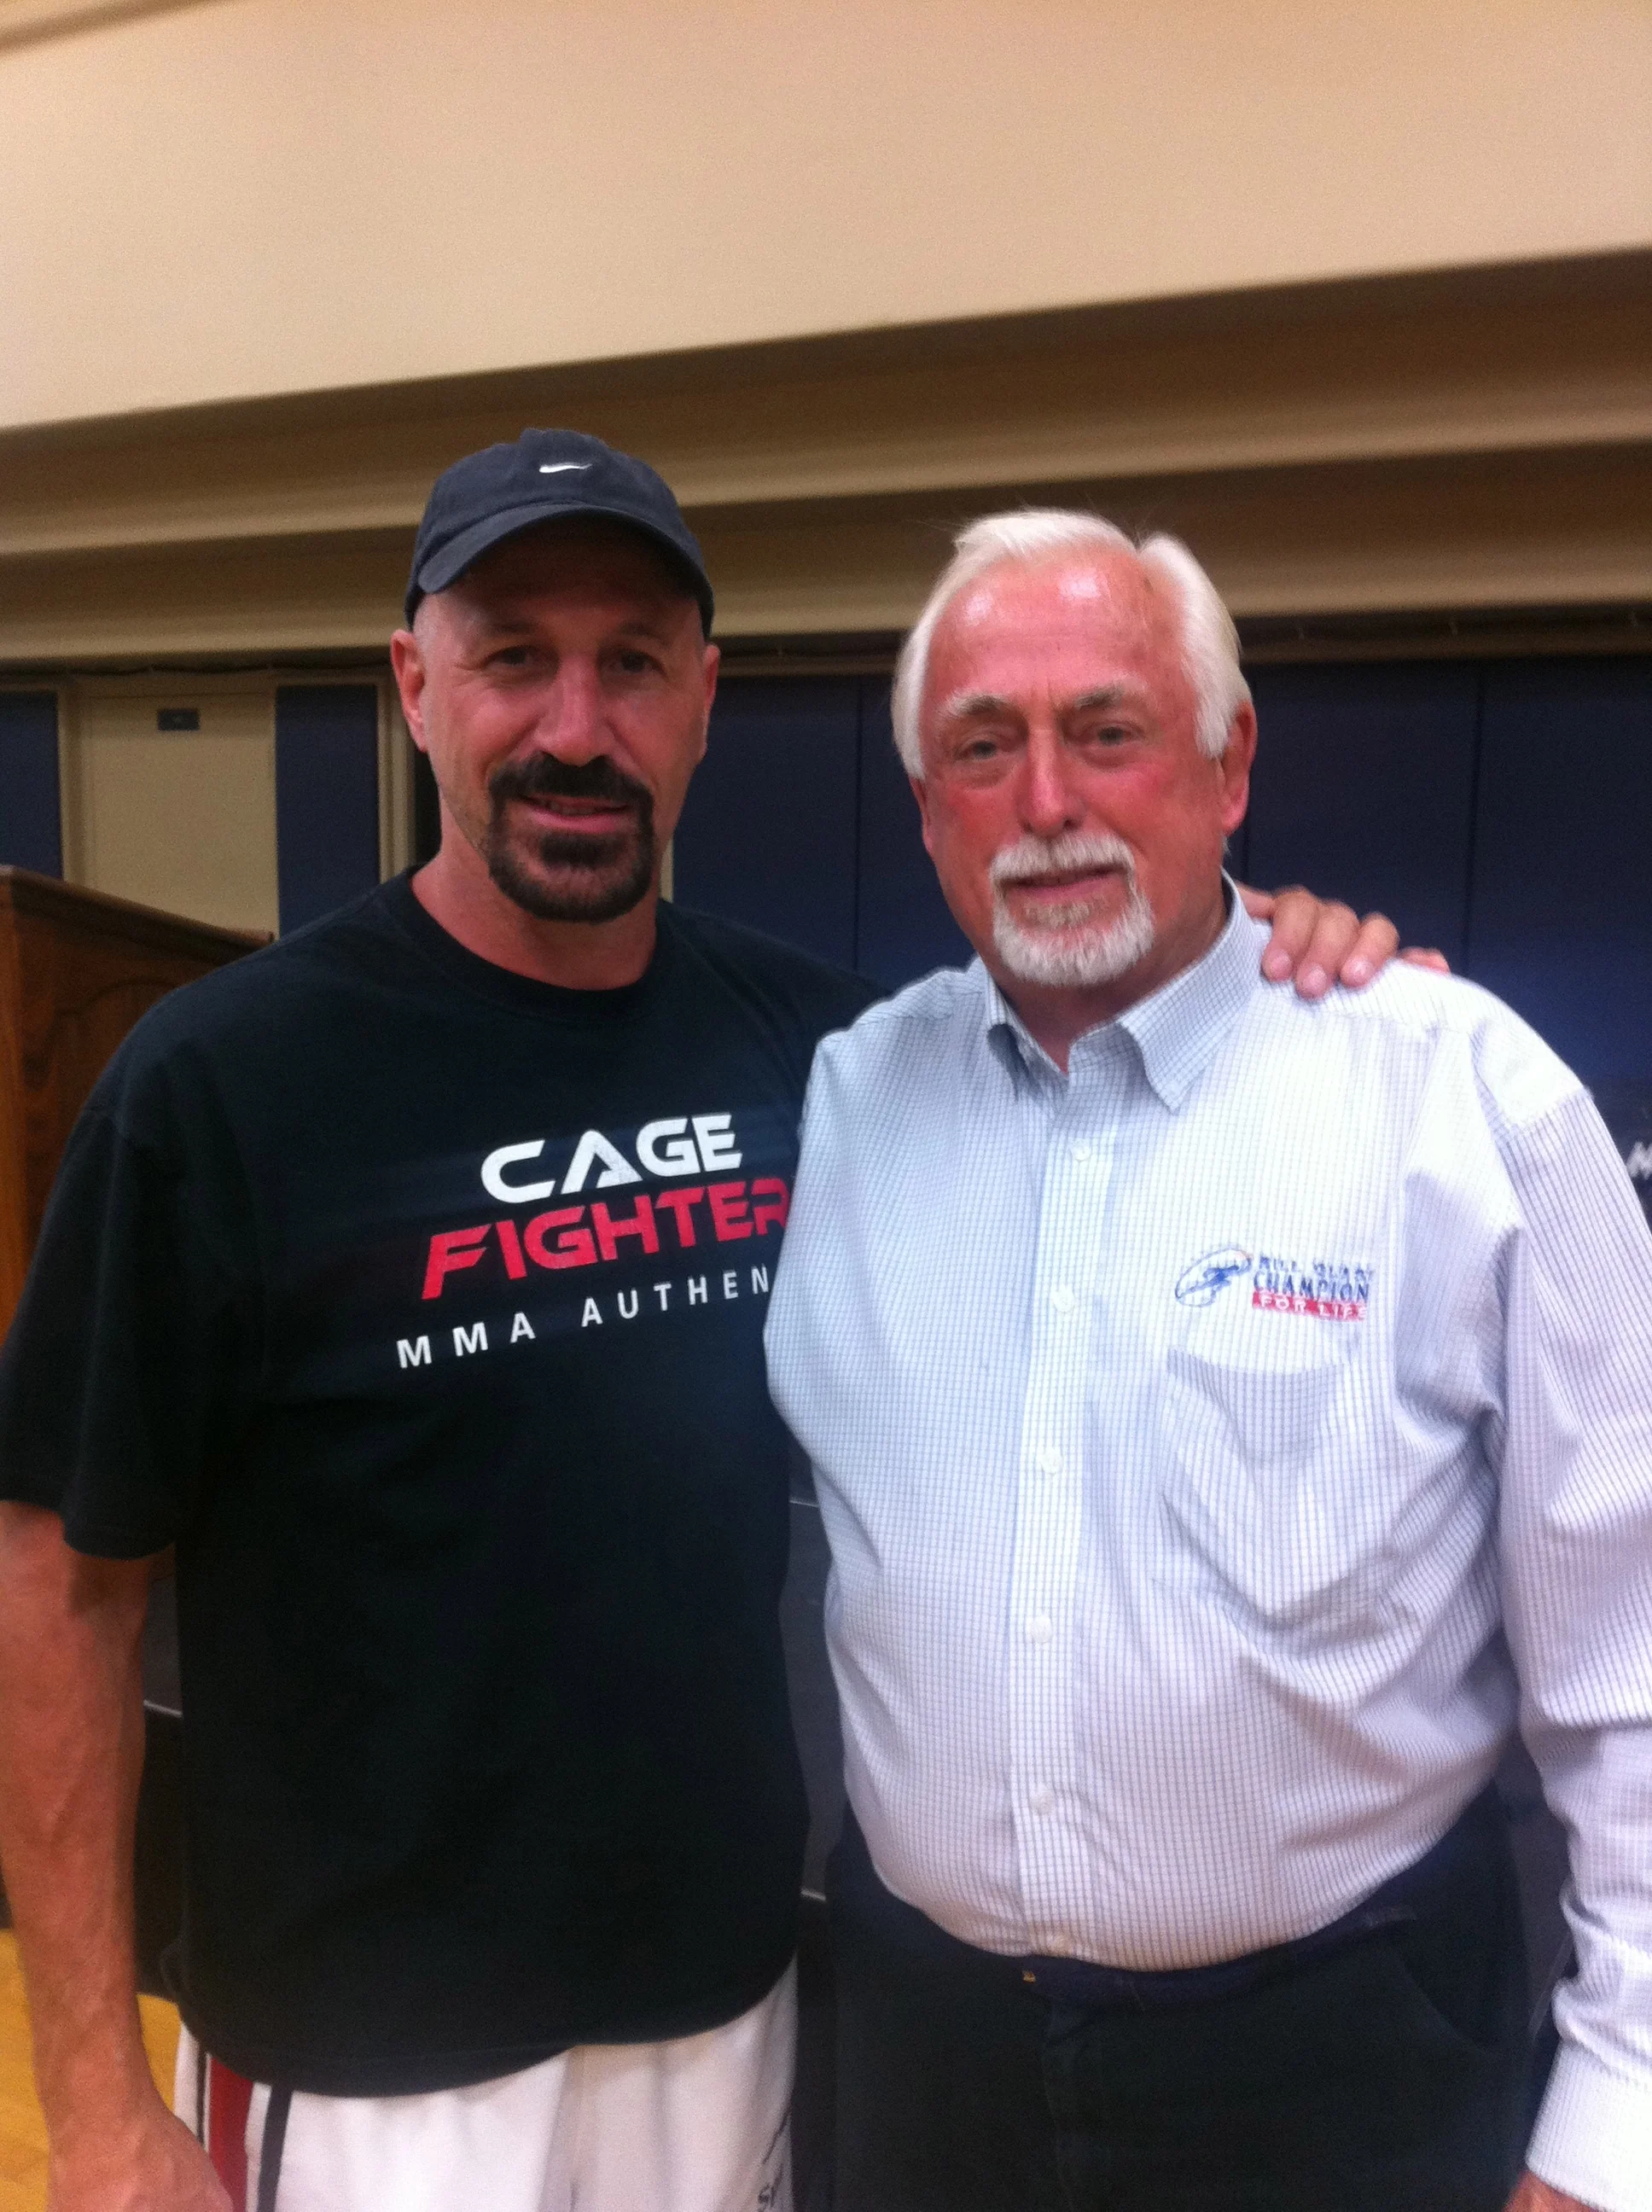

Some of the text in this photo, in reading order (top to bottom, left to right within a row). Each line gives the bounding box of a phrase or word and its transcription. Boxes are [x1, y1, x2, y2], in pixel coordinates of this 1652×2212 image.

[480, 1112, 742, 1204] CAGE
[422, 1177, 789, 1300] FIGHTER
[396, 1263, 769, 1368] MMA AUTHEN
[1260, 1293, 1369, 1321] FOR LIFE
